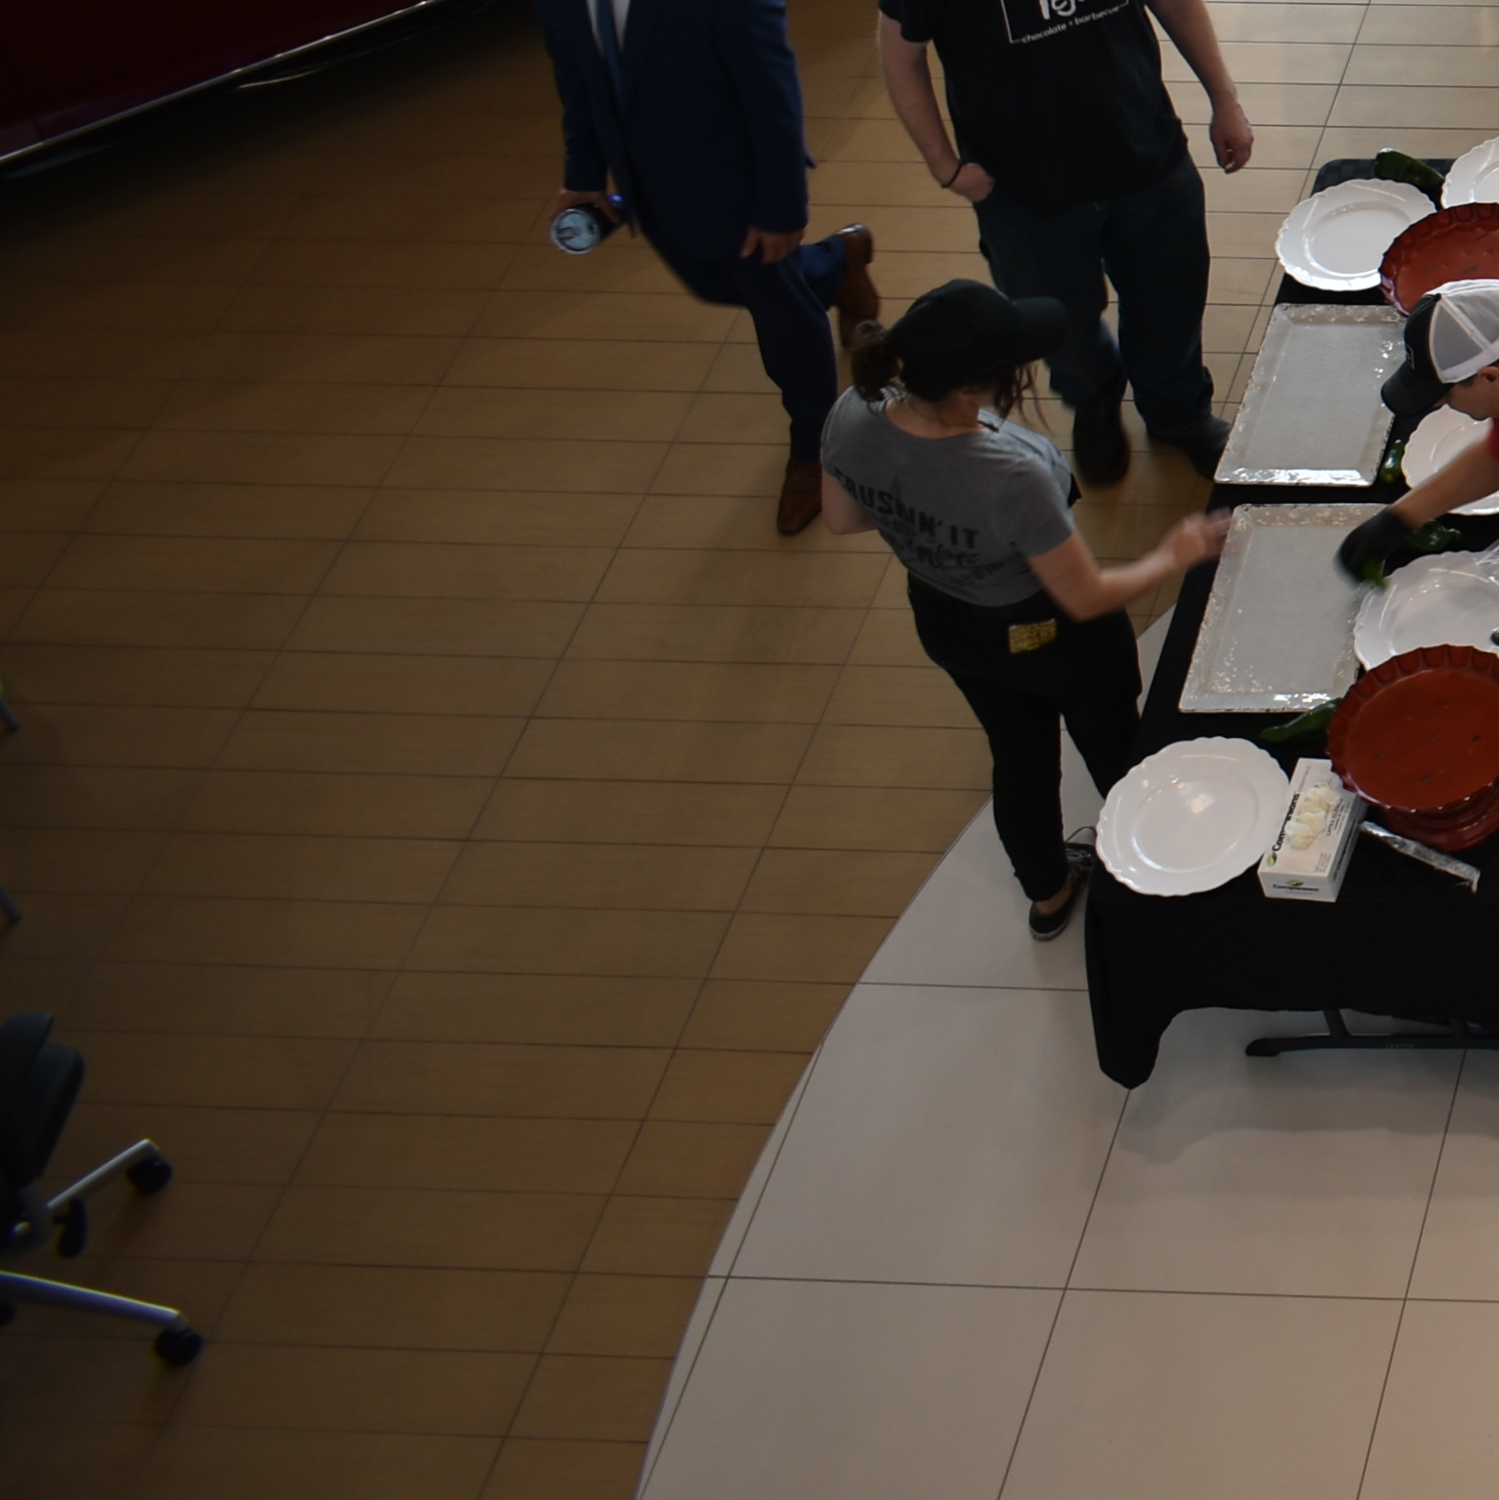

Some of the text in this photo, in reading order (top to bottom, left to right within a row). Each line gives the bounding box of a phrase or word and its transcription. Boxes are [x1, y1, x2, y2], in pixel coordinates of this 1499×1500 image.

[1021, 22, 1067, 44] chocolate
[1074, 5, 1120, 25] barbecue
[949, 525, 979, 549] IT
